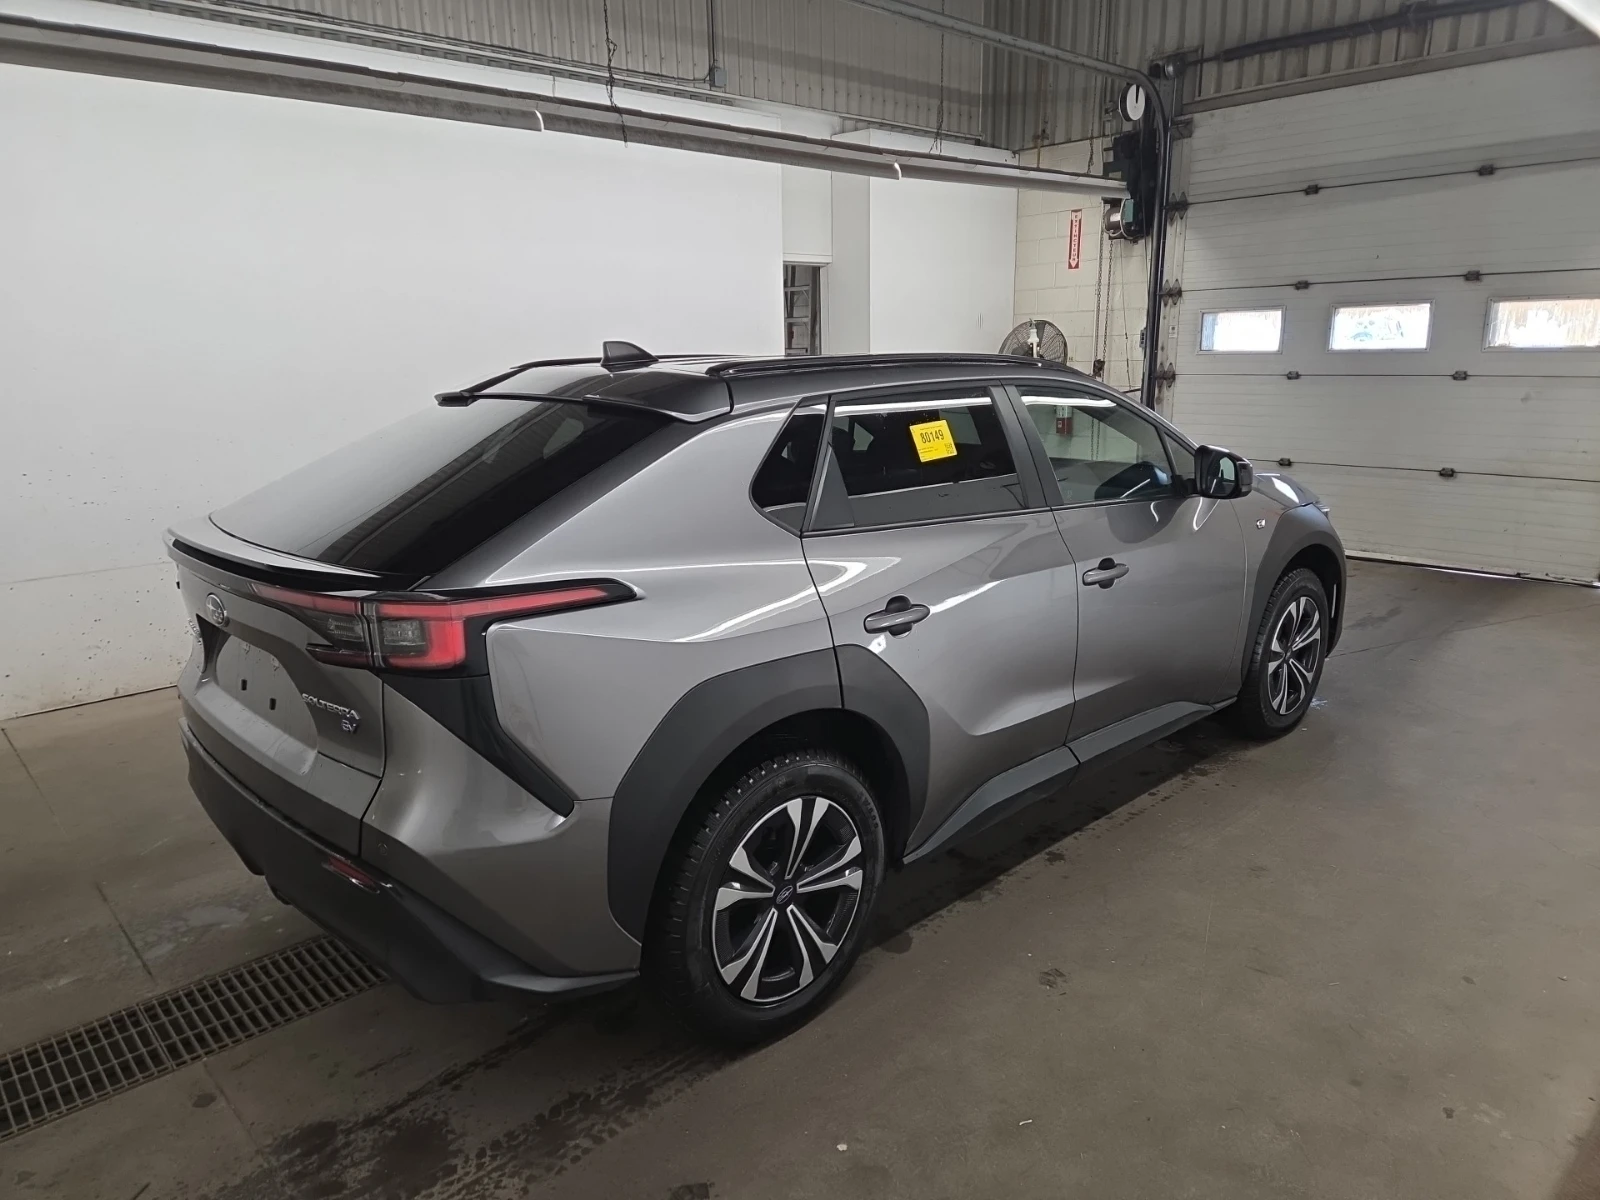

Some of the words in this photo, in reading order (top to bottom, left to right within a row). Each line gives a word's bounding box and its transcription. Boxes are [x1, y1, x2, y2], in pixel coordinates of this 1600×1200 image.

[1071, 214, 1079, 262] EXTINCTEUR
[919, 429, 945, 444] 80149
[301, 692, 360, 720] SOLTERRA
